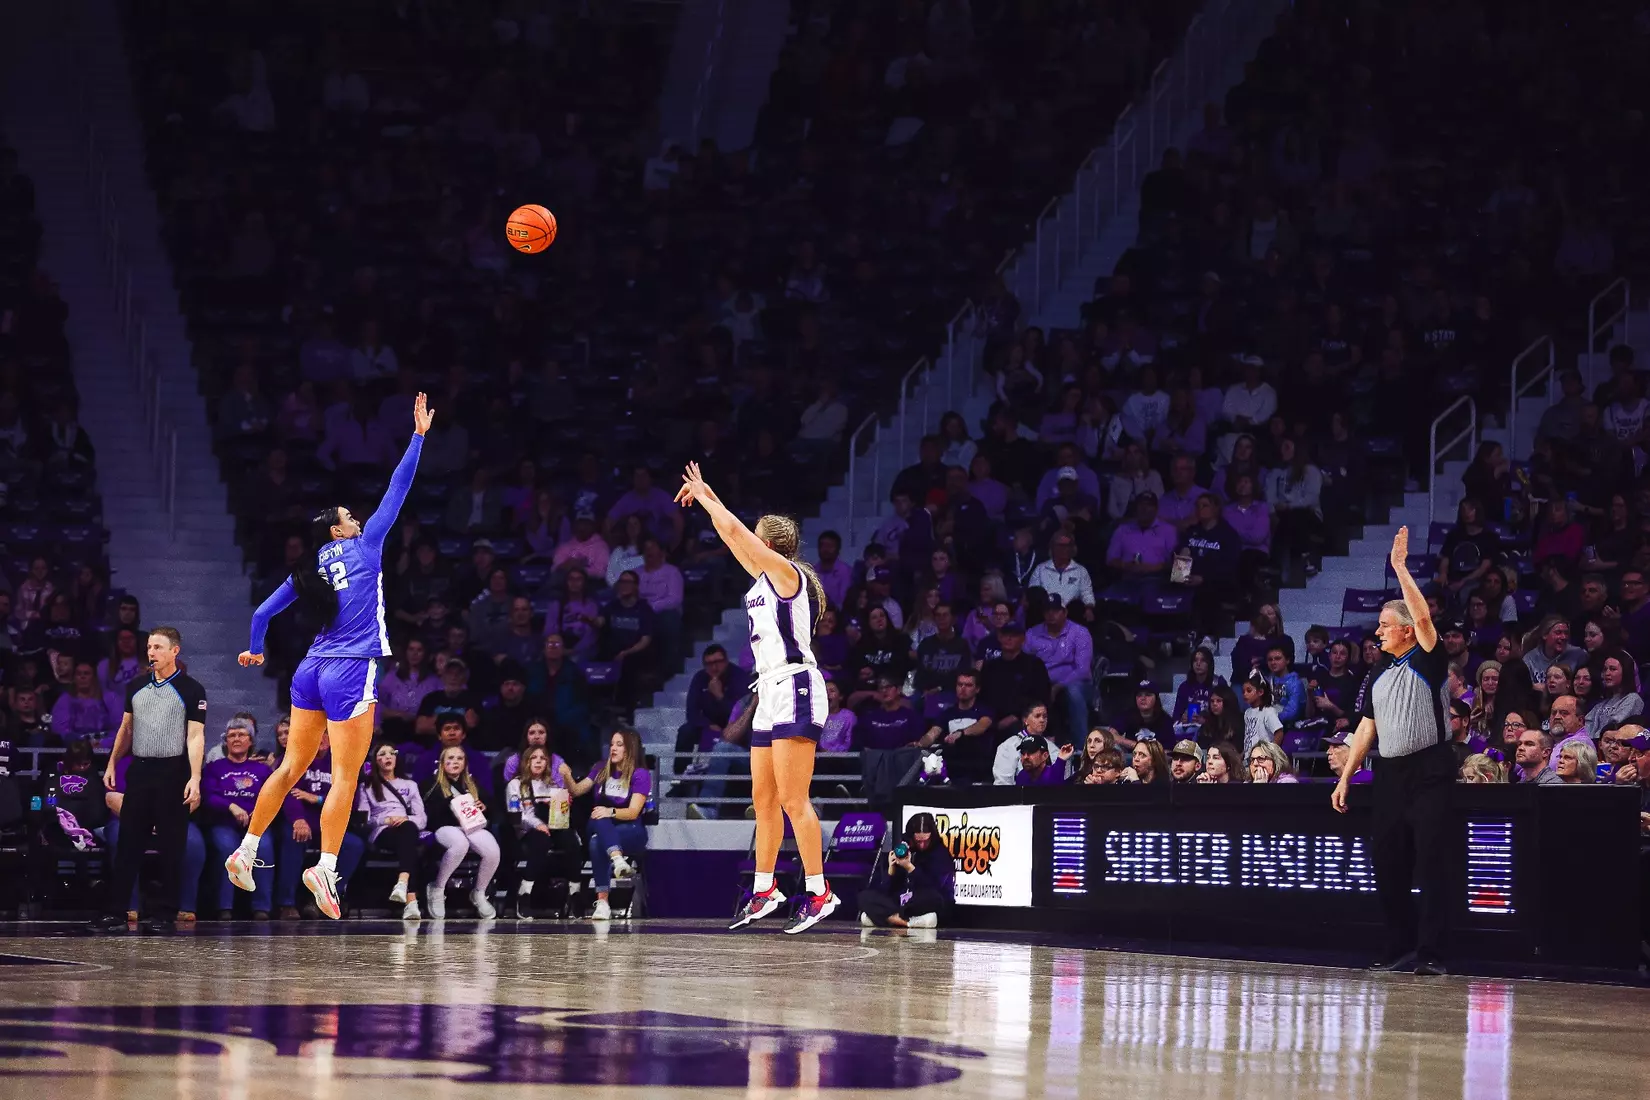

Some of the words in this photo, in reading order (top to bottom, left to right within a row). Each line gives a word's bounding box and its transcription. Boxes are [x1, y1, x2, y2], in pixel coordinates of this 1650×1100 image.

[839, 834, 876, 844] RESERVED
[934, 811, 1001, 875] Briggs
[1104, 830, 1231, 887] SHELTER
[1239, 833, 1379, 893] INSURA
[959, 884, 1003, 900] HEADQUARTERS
